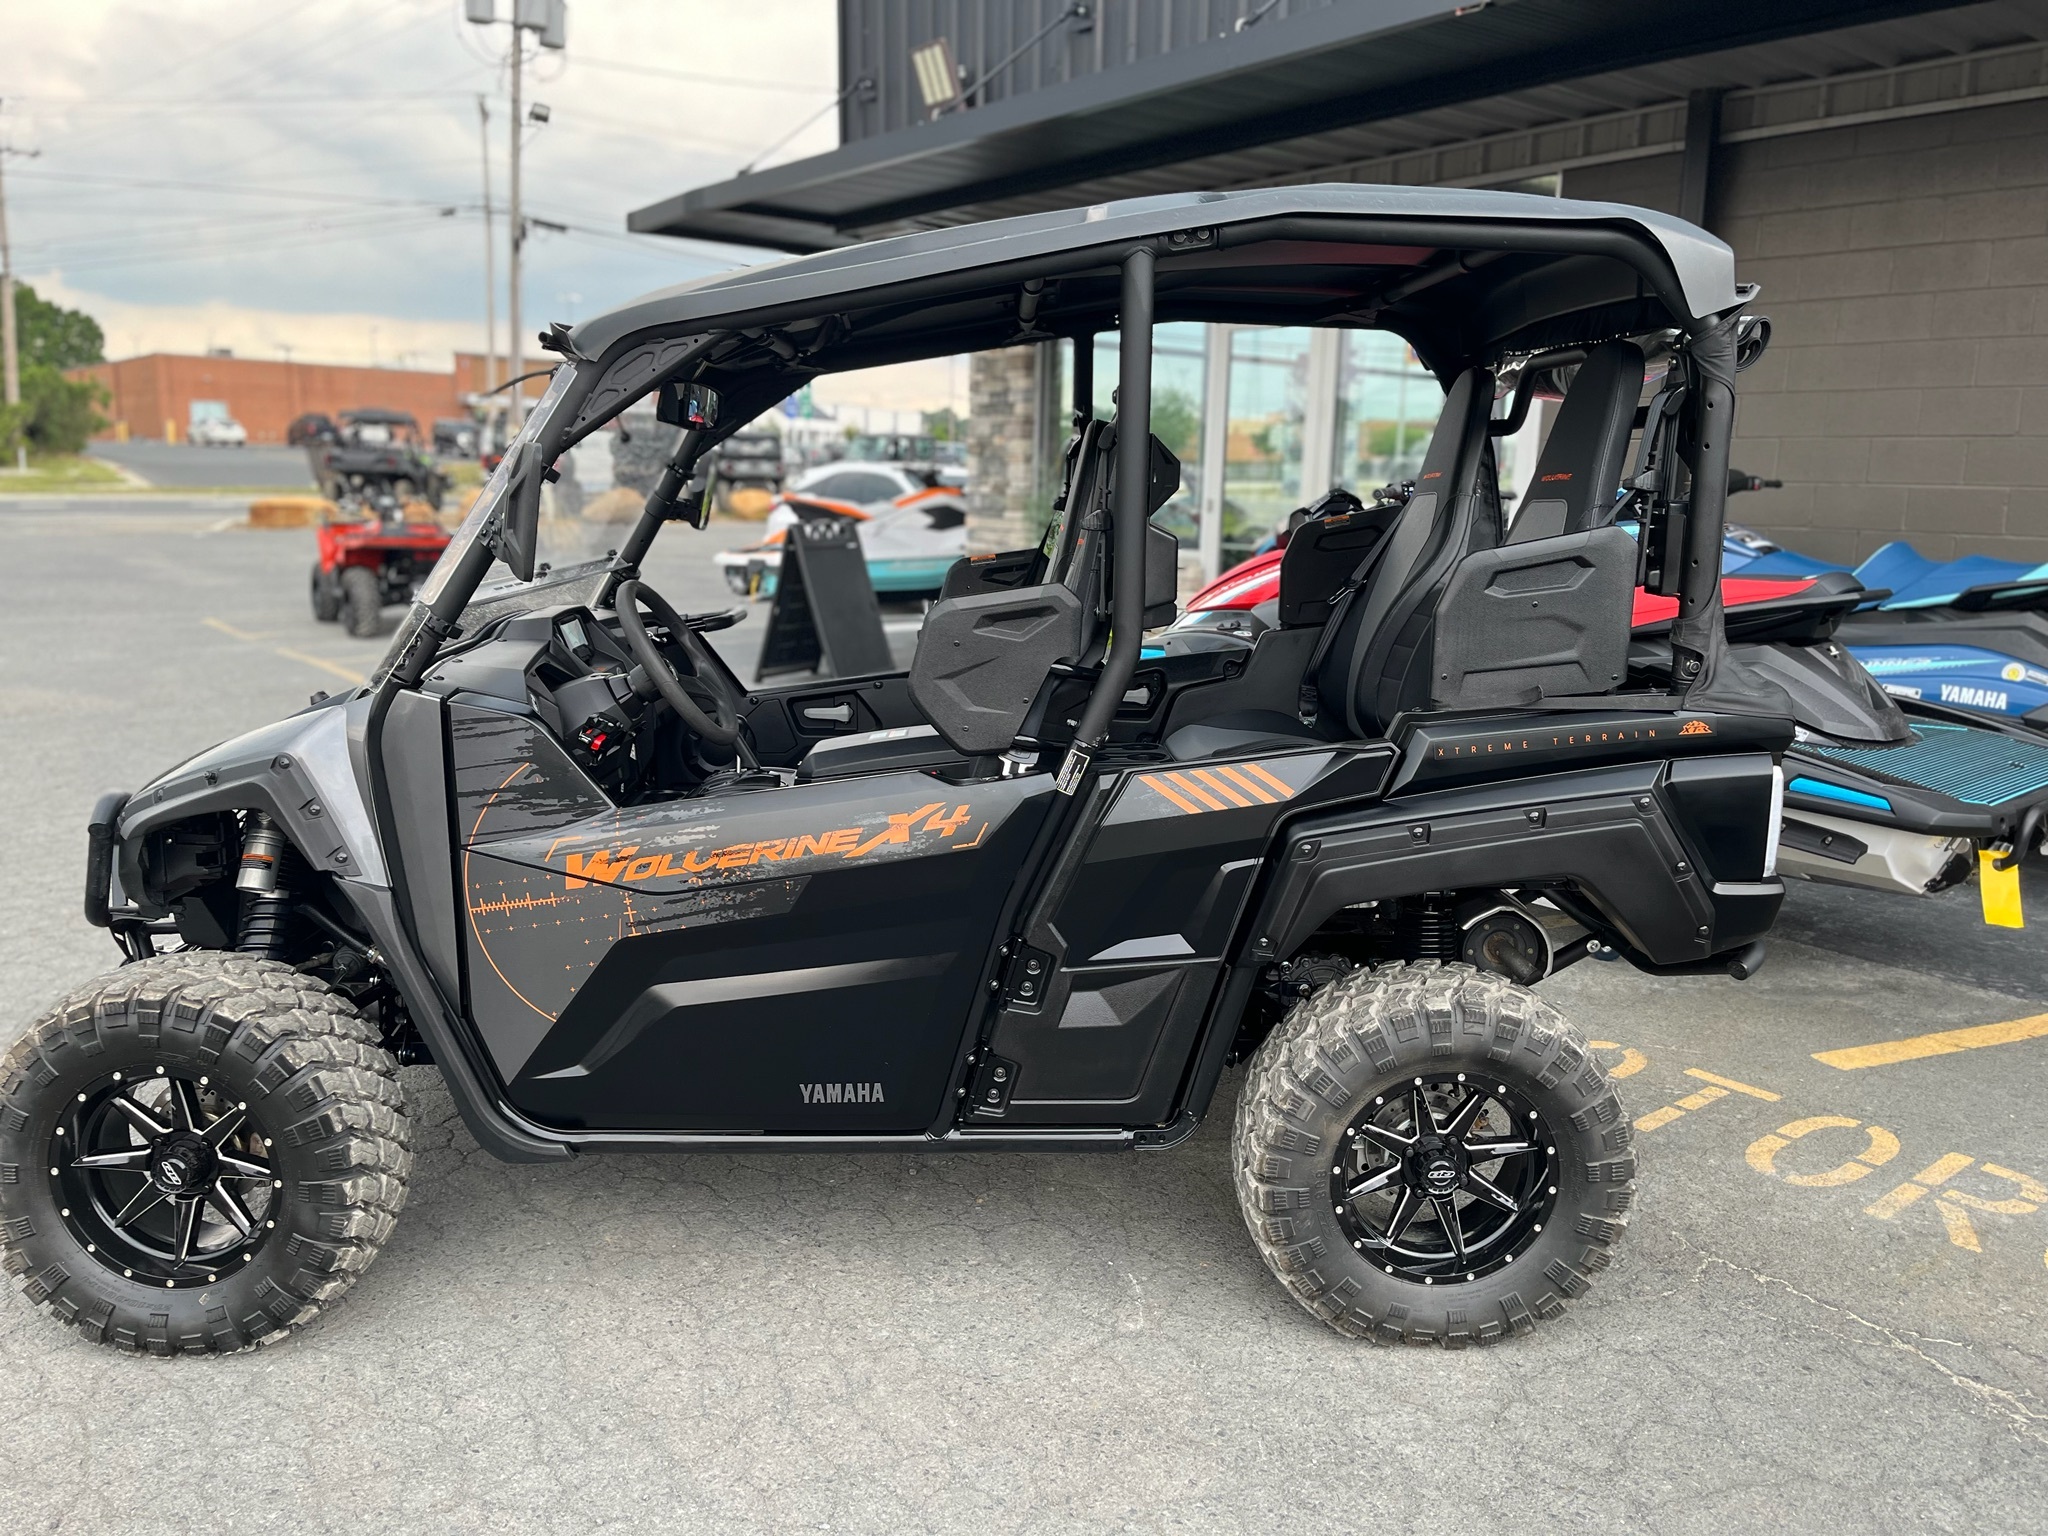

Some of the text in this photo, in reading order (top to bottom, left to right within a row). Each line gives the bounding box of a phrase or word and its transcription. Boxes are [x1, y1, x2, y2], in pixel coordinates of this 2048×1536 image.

[1941, 684, 2007, 710] YAMAHA
[1438, 729, 1656, 756] XTREME TERRAIN
[565, 801, 971, 891] WOLVERINE X4
[799, 1083, 884, 1103] YAMAHA
